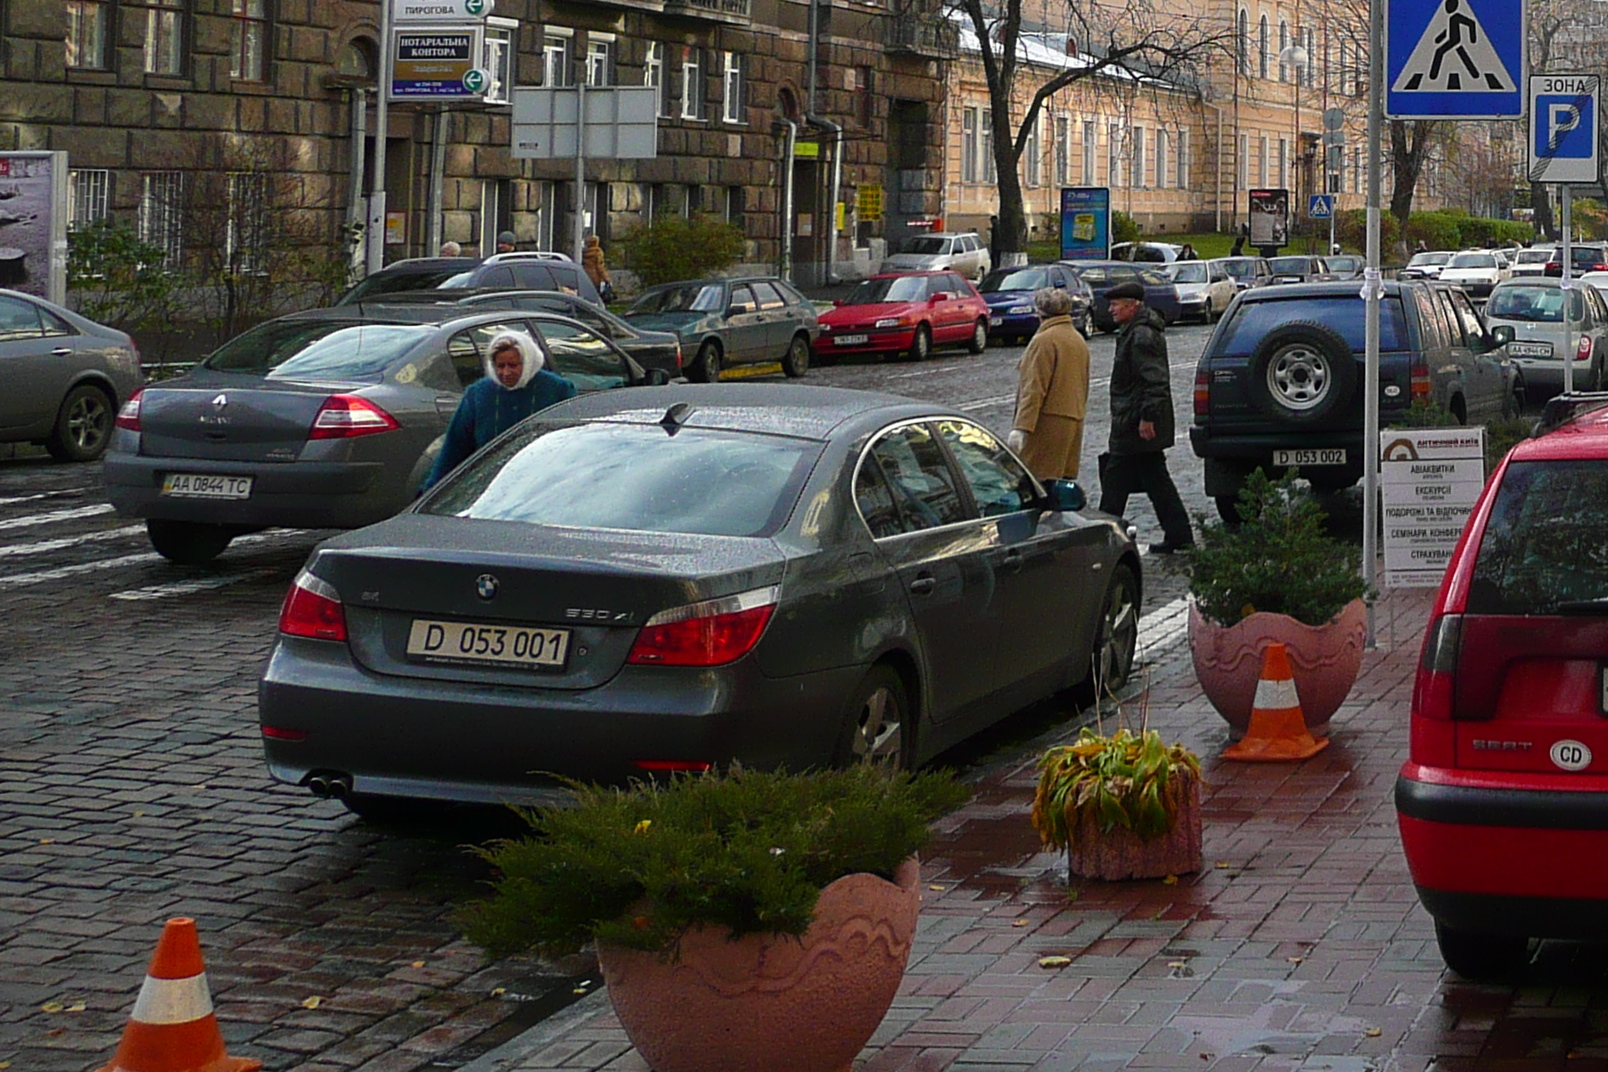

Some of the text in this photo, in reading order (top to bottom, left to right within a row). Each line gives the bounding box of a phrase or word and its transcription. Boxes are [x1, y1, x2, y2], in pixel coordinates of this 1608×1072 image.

[405, 6, 455, 15] ПИРОГОВА
[401, 37, 468, 47] НОТАРІАЛЬНА
[411, 47, 456, 57] КОНТОРА
[1544, 79, 1586, 93] ЗОНА
[1279, 450, 1343, 464] D 053 002
[1411, 464, 1455, 474] АВІАКВИТКИ
[172, 477, 247, 494] AA 0844 TC
[1427, 506, 1434, 516] ТА
[566, 608, 611, 620] 530
[424, 624, 562, 660] D 053 001
[1472, 739, 1533, 752] SEAT
[1559, 745, 1582, 765] CD
